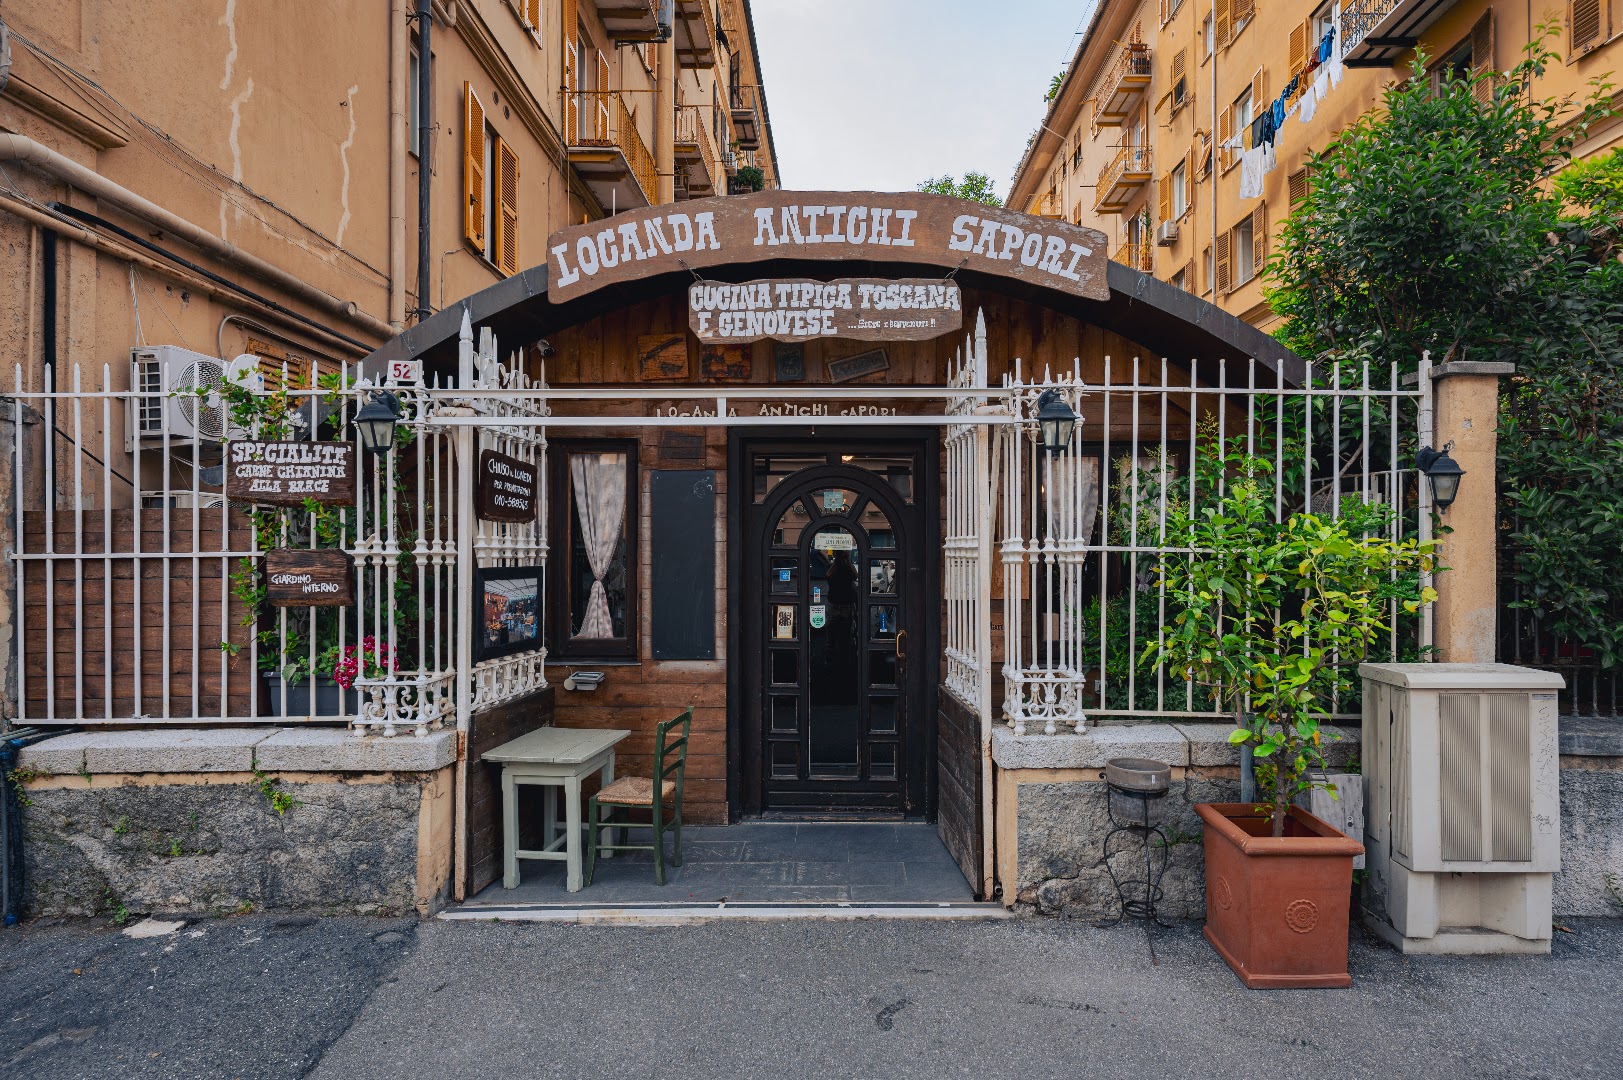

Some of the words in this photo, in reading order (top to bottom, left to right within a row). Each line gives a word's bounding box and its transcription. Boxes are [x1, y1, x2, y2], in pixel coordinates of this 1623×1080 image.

[551, 211, 721, 289] LOCANDA
[753, 205, 918, 247] ANTICHI
[949, 214, 1093, 281] SAPORI
[690, 283, 772, 311] CUCINA
[775, 283, 853, 310] TIPICA
[858, 284, 960, 311] TOSCANA
[698, 312, 713, 337] E
[718, 308, 838, 337] GENOVESE
[393, 363, 411, 379] 52
[759, 402, 829, 417] ANTICHI
[235, 464, 273, 478] CARNE
[277, 464, 346, 478] CHIANINA
[488, 458, 510, 476] CHIUSO
[249, 479, 282, 493] ALLA
[288, 479, 330, 493] BRACE
[271, 574, 312, 585] GIARDINO
[302, 582, 339, 594] INTERNO
